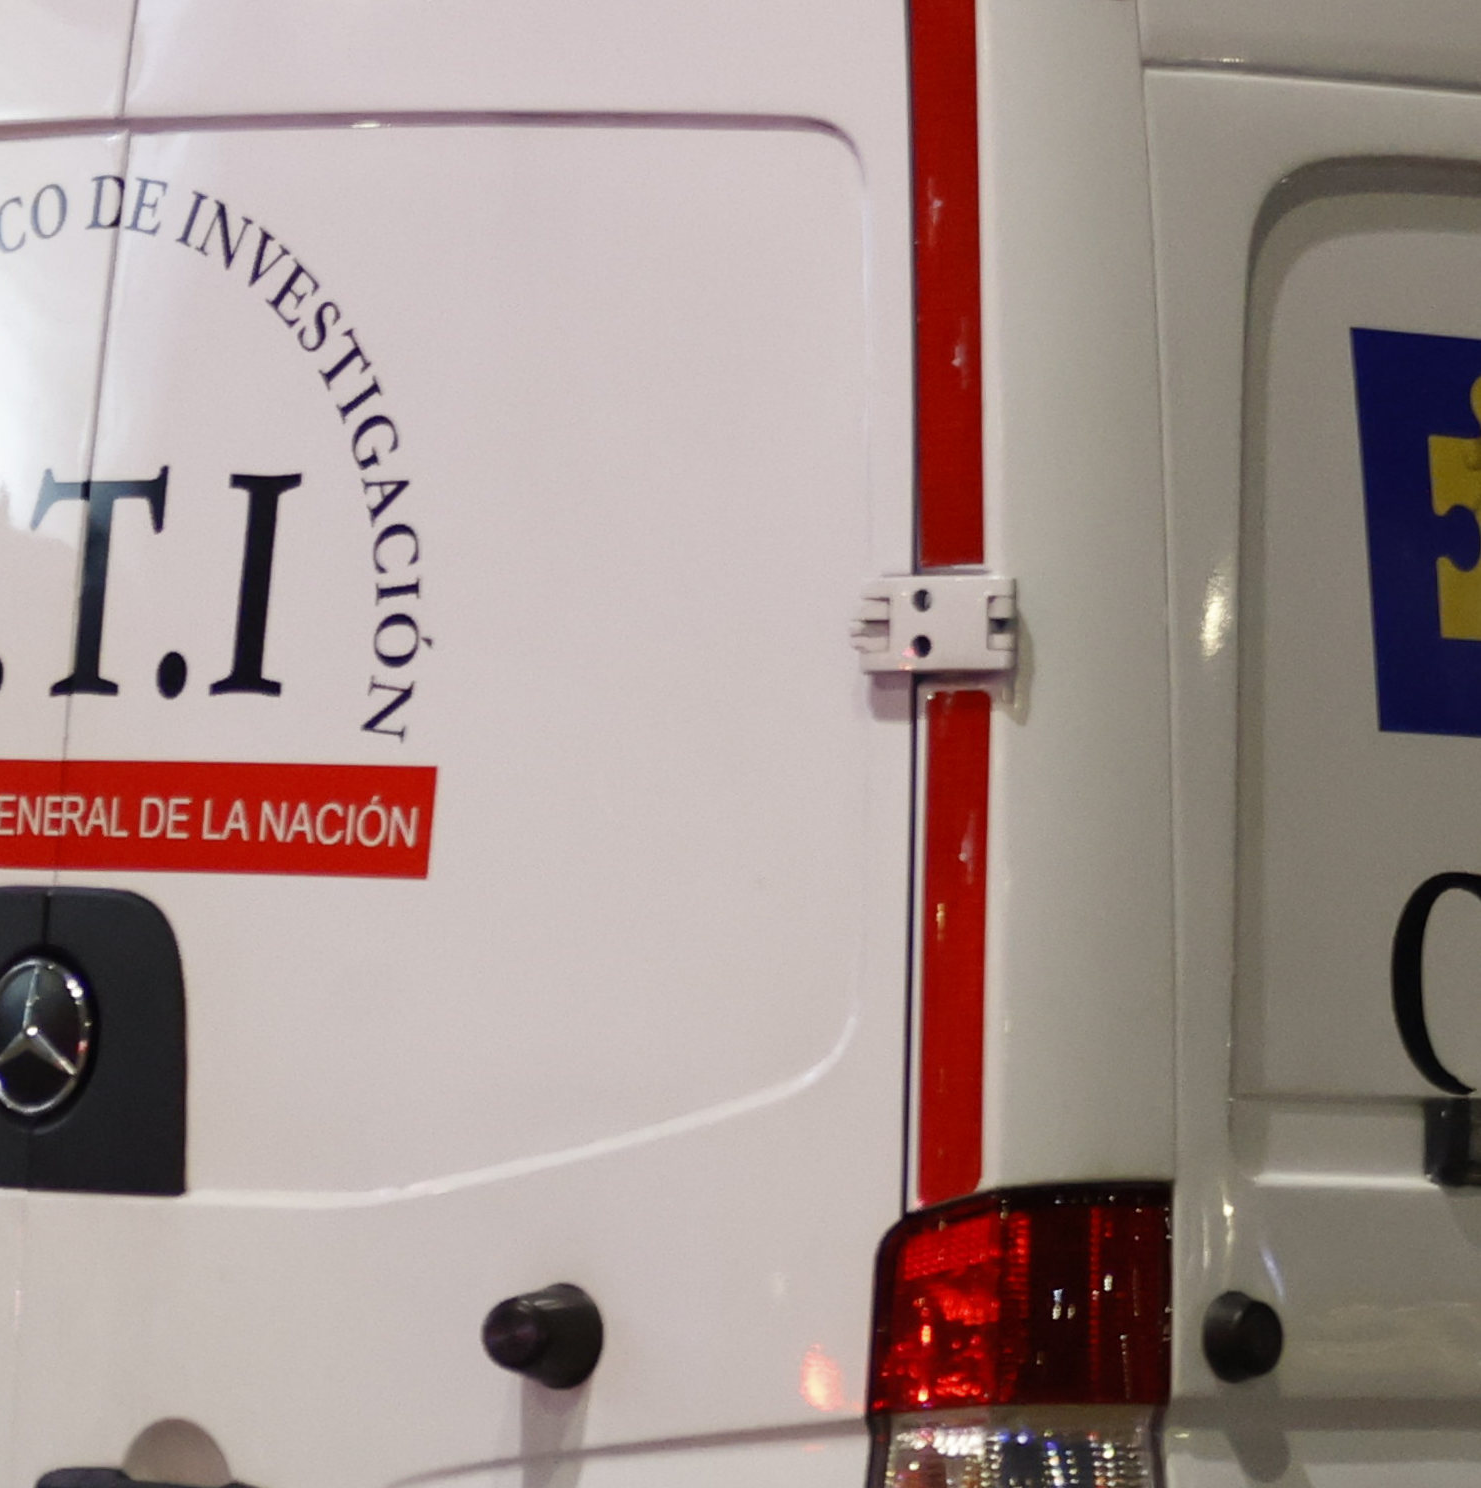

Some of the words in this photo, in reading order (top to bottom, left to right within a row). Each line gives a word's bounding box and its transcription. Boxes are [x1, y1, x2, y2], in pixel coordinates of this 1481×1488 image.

[85, 174, 169, 236] DE
[175, 190, 434, 743] INVESTIGACIÓN
[140, 797, 192, 839] DE
[202, 798, 249, 842] LA
[258, 795, 420, 848] NACIÓN
